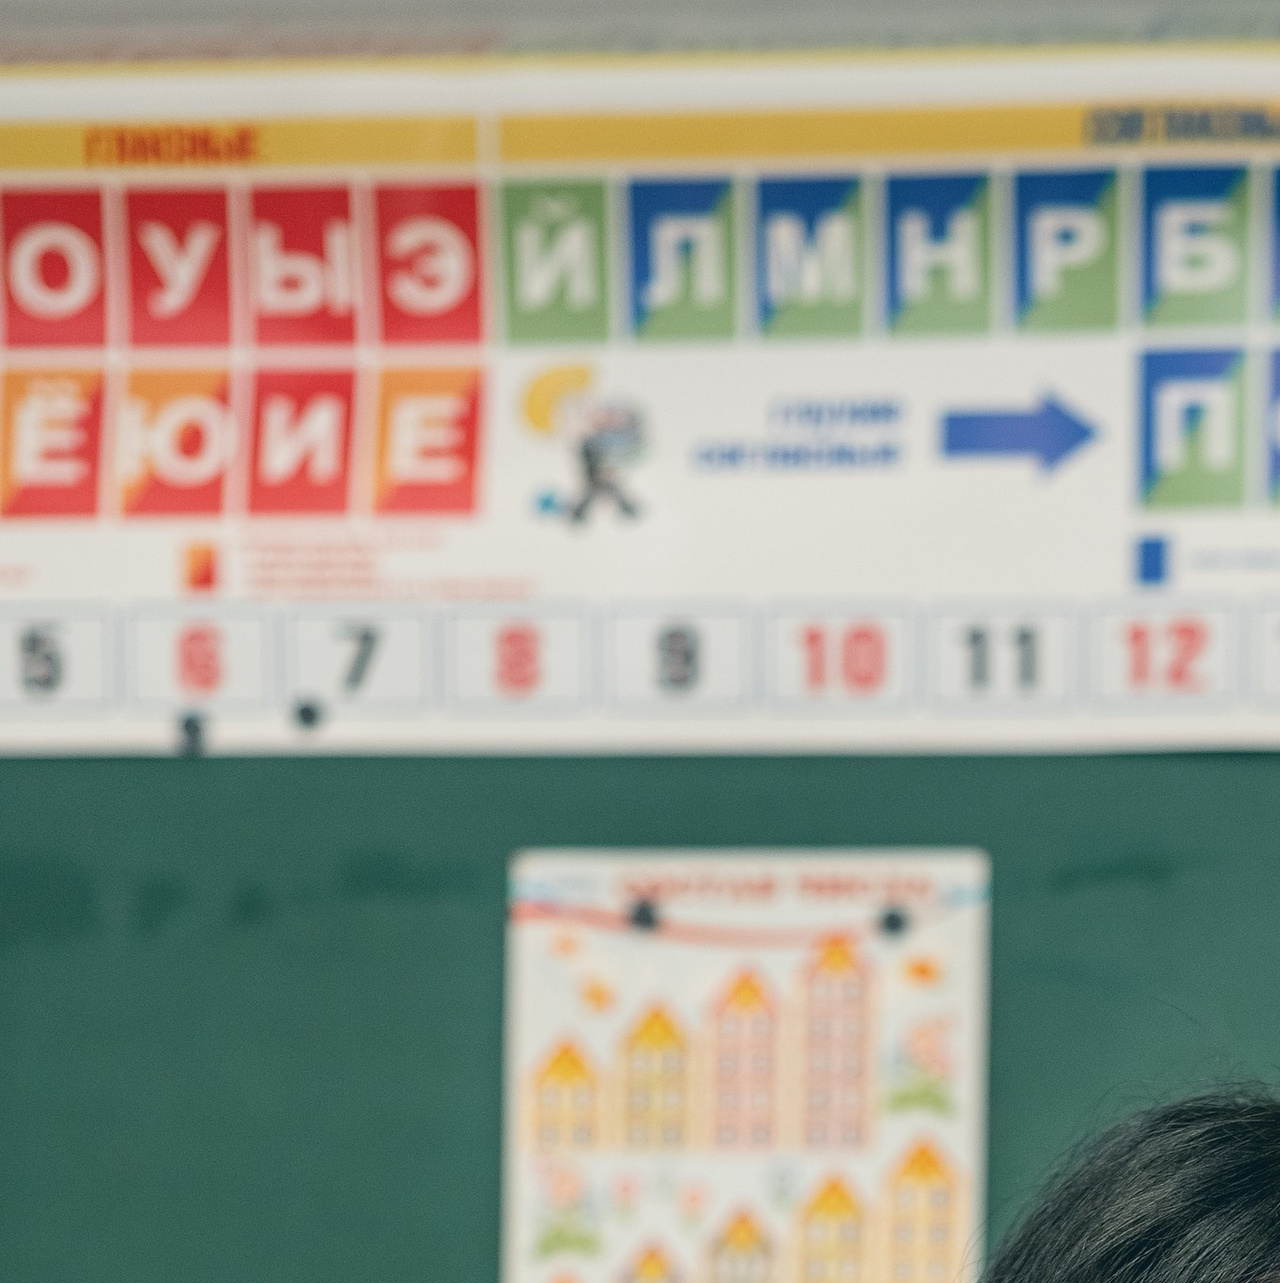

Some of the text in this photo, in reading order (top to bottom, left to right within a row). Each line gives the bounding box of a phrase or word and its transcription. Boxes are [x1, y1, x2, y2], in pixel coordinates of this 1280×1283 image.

[8, 217, 475, 318] О У Ы Э
[517, 195, 594, 309] Й
[643, 214, 723, 308] Л
[766, 214, 857, 306] М
[899, 209, 978, 302] Н
[1031, 207, 1105, 299] Р
[1158, 202, 1238, 292] Б
[14, 380, 466, 487] Ё Ю И Е
[1156, 380, 1235, 470] П
[20, 622, 63, 695] 5
[176, 622, 225, 695] 6
[337, 622, 381, 693] 7
[494, 622, 543, 696] 8
[655, 622, 701, 693] 9
[802, 622, 887, 693] 10
[966, 622, 1040, 689] 11
[1124, 622, 1207, 689] 12
